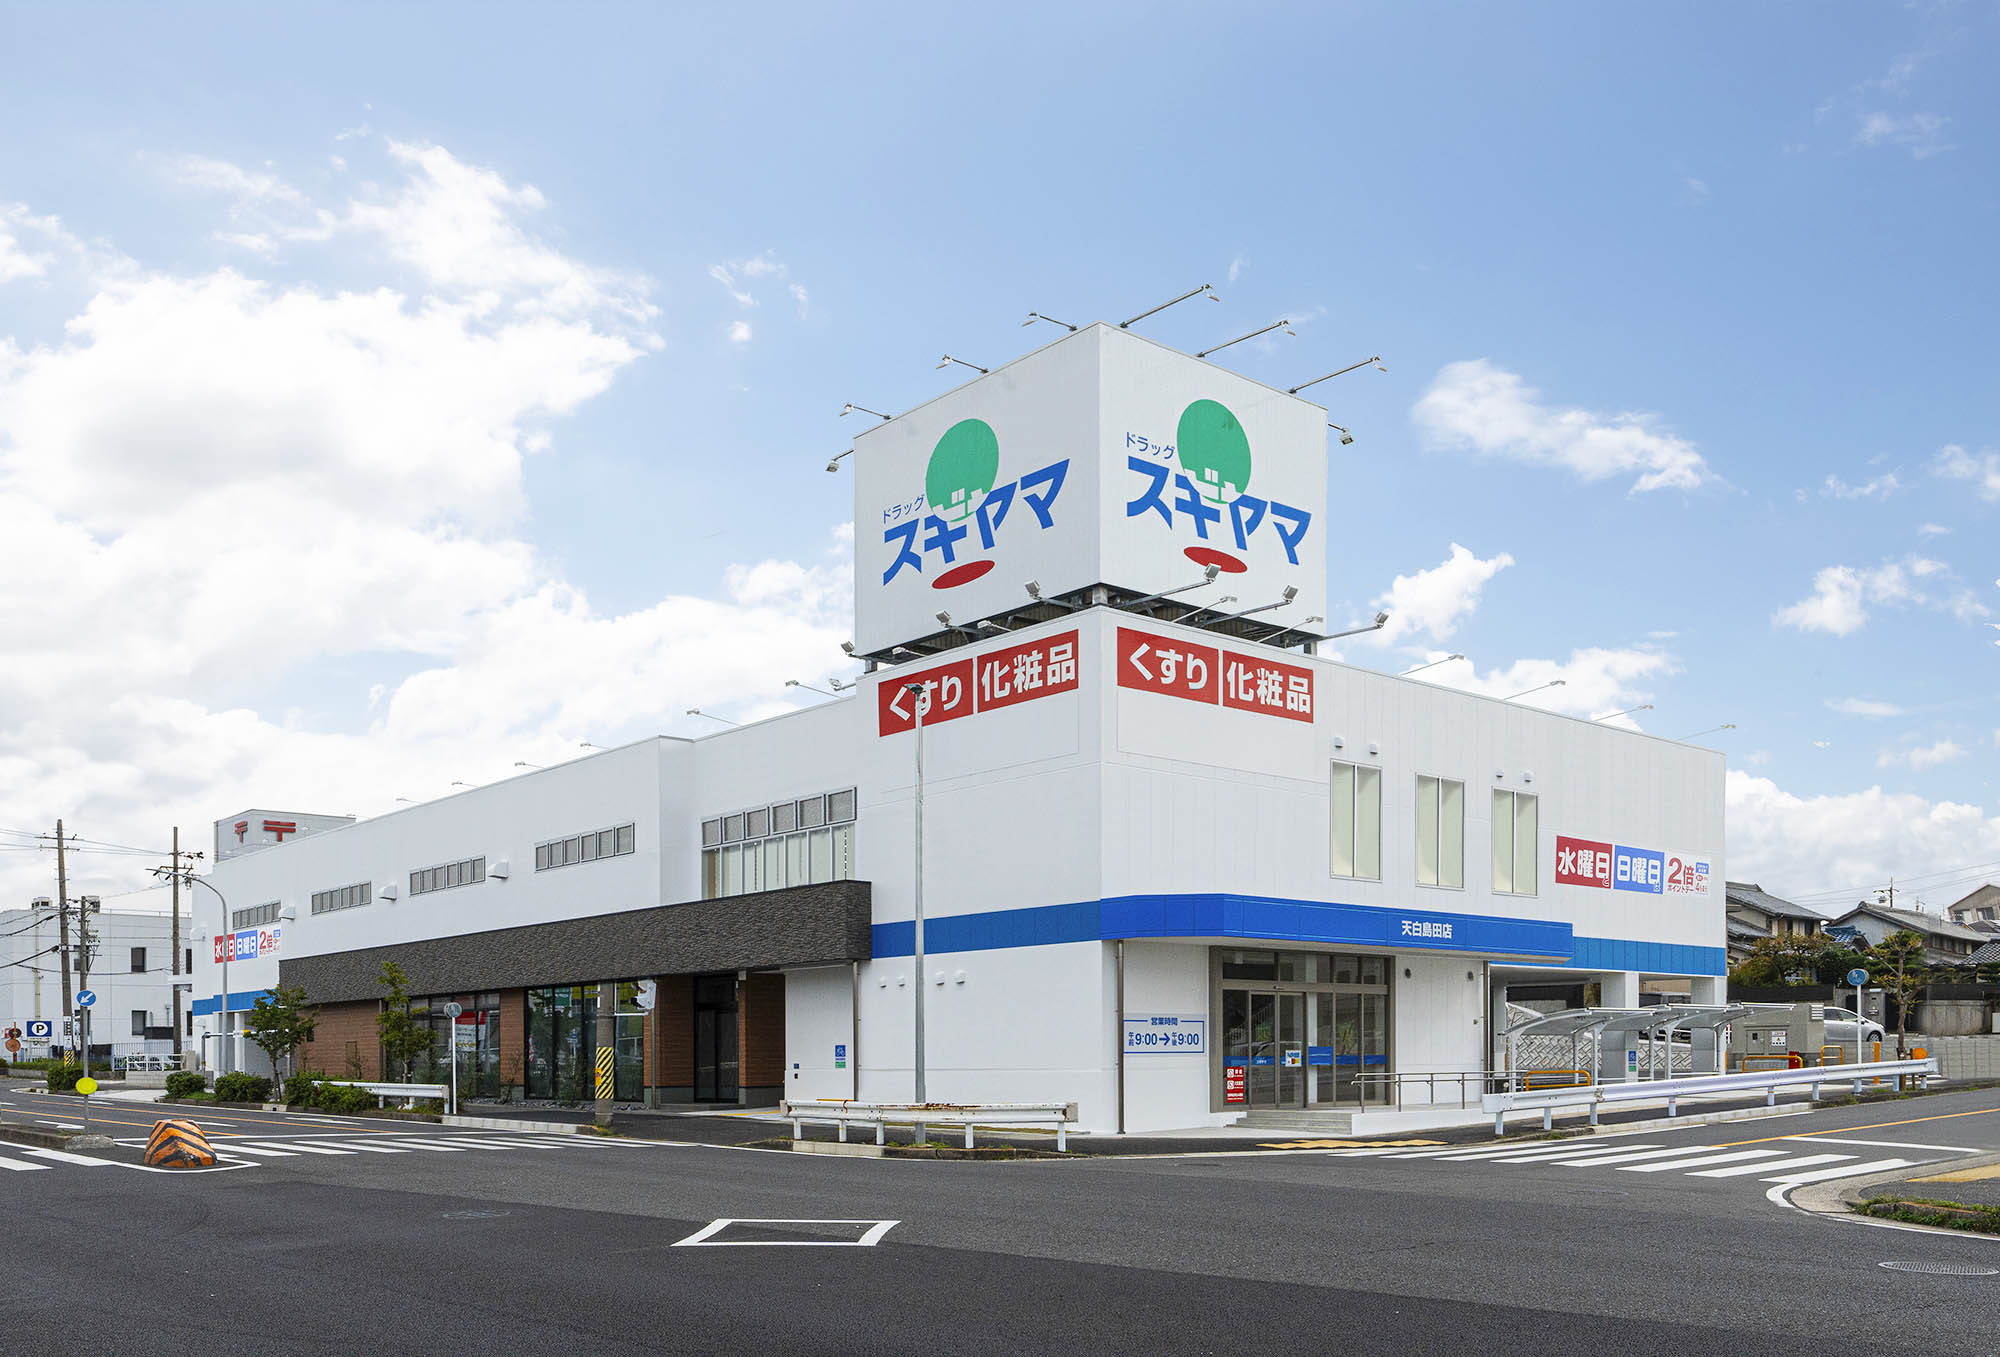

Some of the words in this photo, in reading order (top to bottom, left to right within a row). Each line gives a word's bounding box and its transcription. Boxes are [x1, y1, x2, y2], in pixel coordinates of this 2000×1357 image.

[1125, 431, 1176, 460] ドラッグ
[882, 494, 925, 521] ドラッグ
[1126, 456, 1311, 565] スギヤマ
[883, 459, 1070, 586] スギヤマ
[888, 675, 962, 722] くすり
[981, 642, 1074, 702] 化粧品
[1129, 642, 1208, 690] くすり
[1226, 662, 1311, 714] 化粧品
[1667, 857, 1694, 886] 2倍
[1401, 920, 1453, 939] 天白島田店
[215, 941, 235, 959] 水日
[36, 1025, 44, 1033] P
[1151, 1017, 1178, 1026] 営業時間
[1128, 1032, 1134, 1046] 午前
[1135, 1033, 1158, 1045] 9:00
[1178, 1033, 1200, 1045] 9:00
